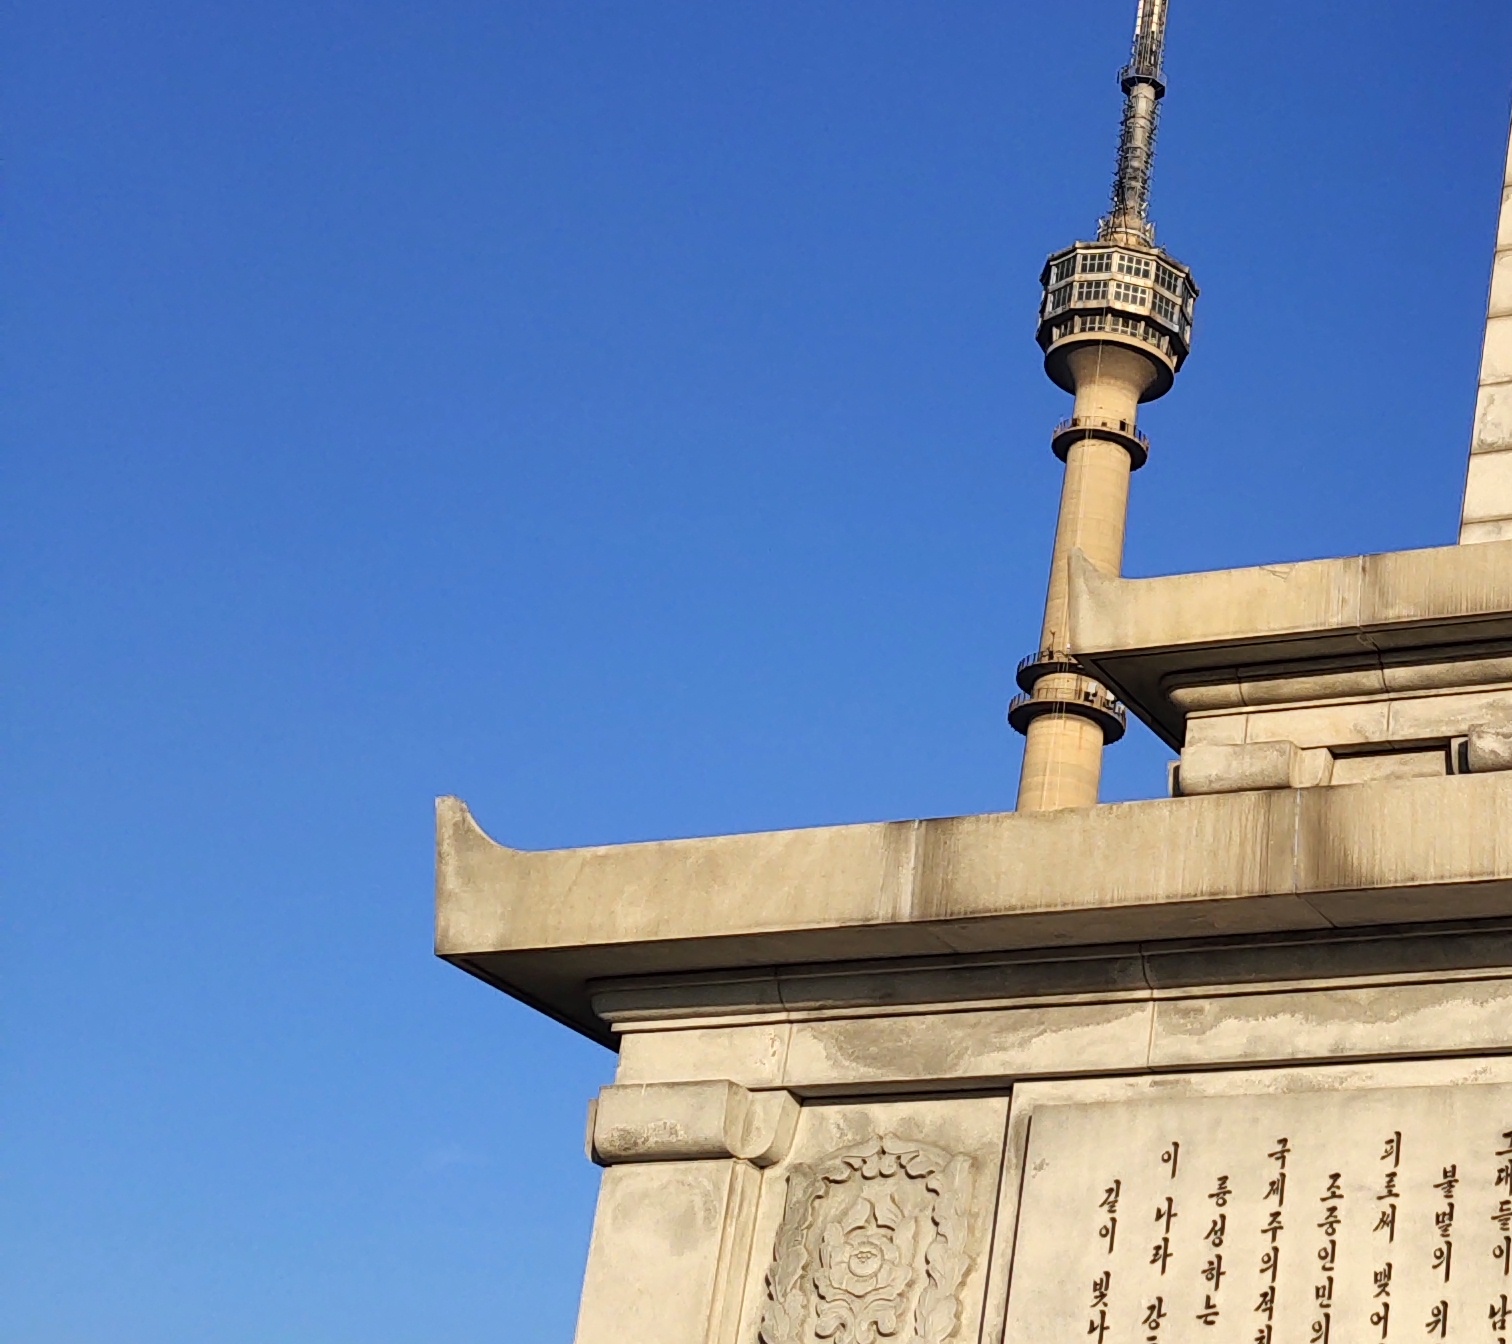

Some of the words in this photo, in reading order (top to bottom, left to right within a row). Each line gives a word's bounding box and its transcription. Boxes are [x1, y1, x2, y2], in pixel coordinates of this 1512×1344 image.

[1161, 1141, 1180, 1179] 이
[1373, 1130, 1402, 1243] 피로써
[1098, 1179, 1122, 1254] 길이
[1149, 1196, 1178, 1276] 나라
[1195, 1175, 1233, 1326] 륭성하는
[1431, 1163, 1460, 1283] 불멸의
